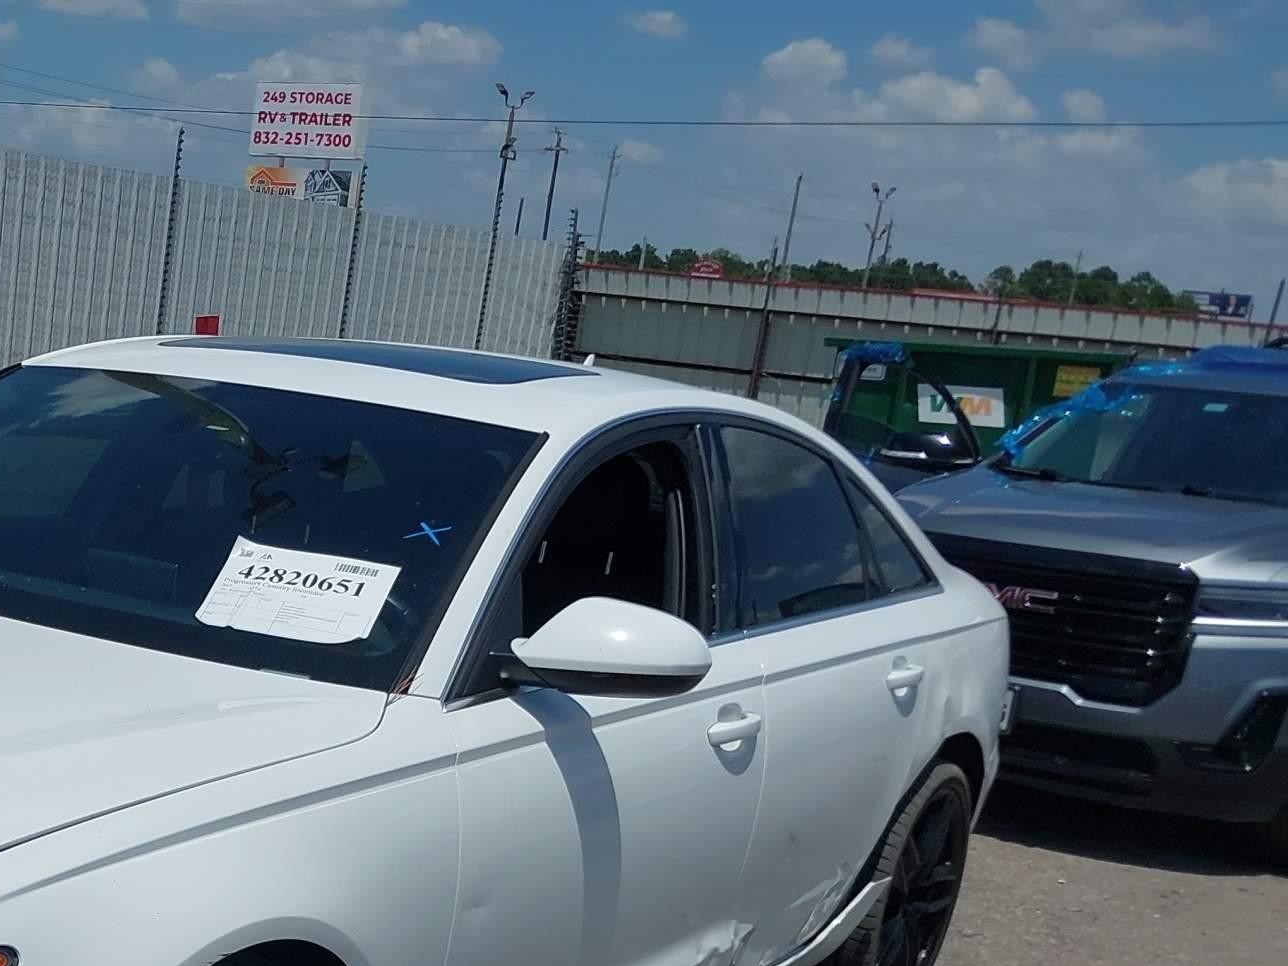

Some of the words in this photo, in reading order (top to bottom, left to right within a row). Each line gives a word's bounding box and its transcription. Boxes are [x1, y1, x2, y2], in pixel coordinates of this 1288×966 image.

[262, 91, 286, 103] 249
[289, 92, 352, 105] STORAGE
[258, 111, 278, 124] RV
[289, 112, 352, 127] TRAILER
[253, 131, 351, 148] 832-251-7300
[278, 187, 296, 196] DAY
[238, 565, 366, 597] 42820651
[983, 583, 1059, 615] MC
